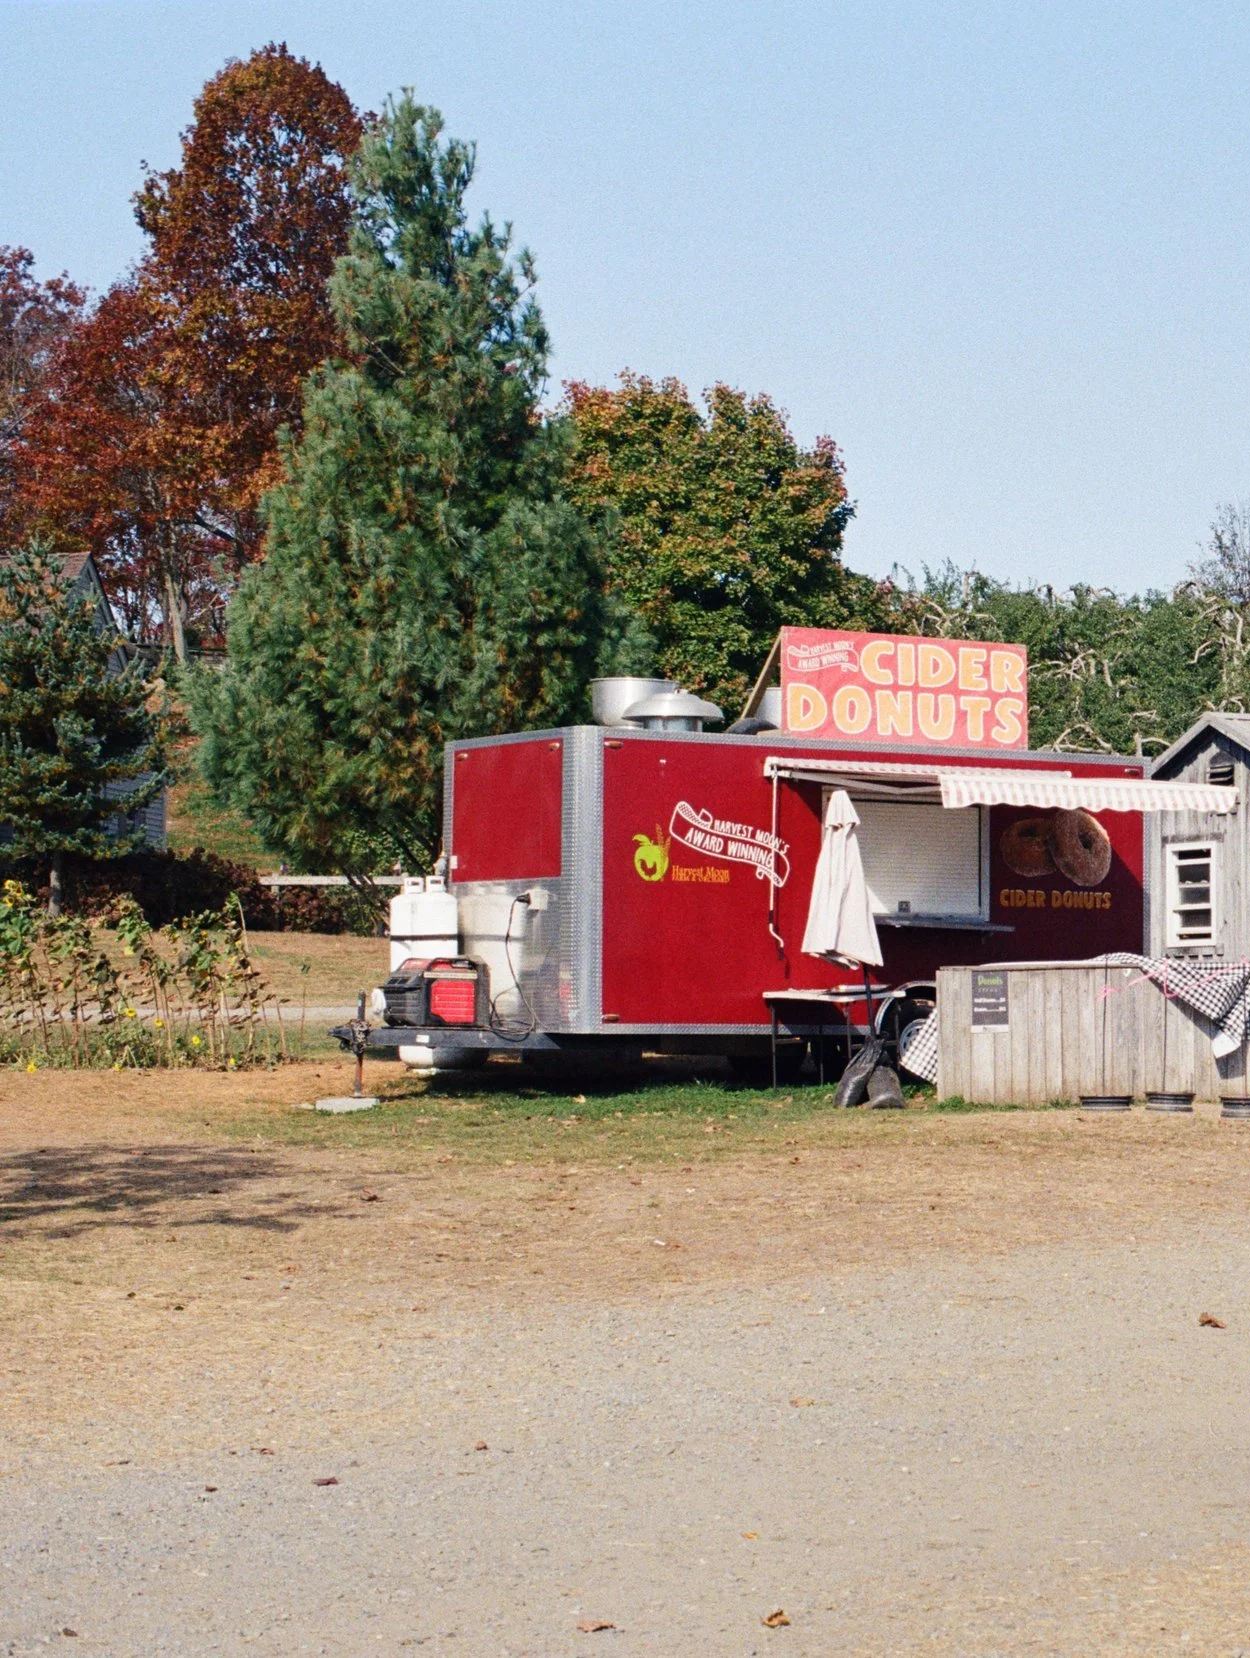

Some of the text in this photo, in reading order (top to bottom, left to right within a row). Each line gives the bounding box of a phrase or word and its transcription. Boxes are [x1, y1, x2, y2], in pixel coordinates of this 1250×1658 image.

[860, 640, 1025, 692] CIDER
[787, 683, 1024, 744] DONUTS
[684, 828, 774, 867] AWARD WINNING
[714, 819, 790, 855] HARVEST MOON'S
[1000, 889, 1112, 909] CIDER DONUTS
